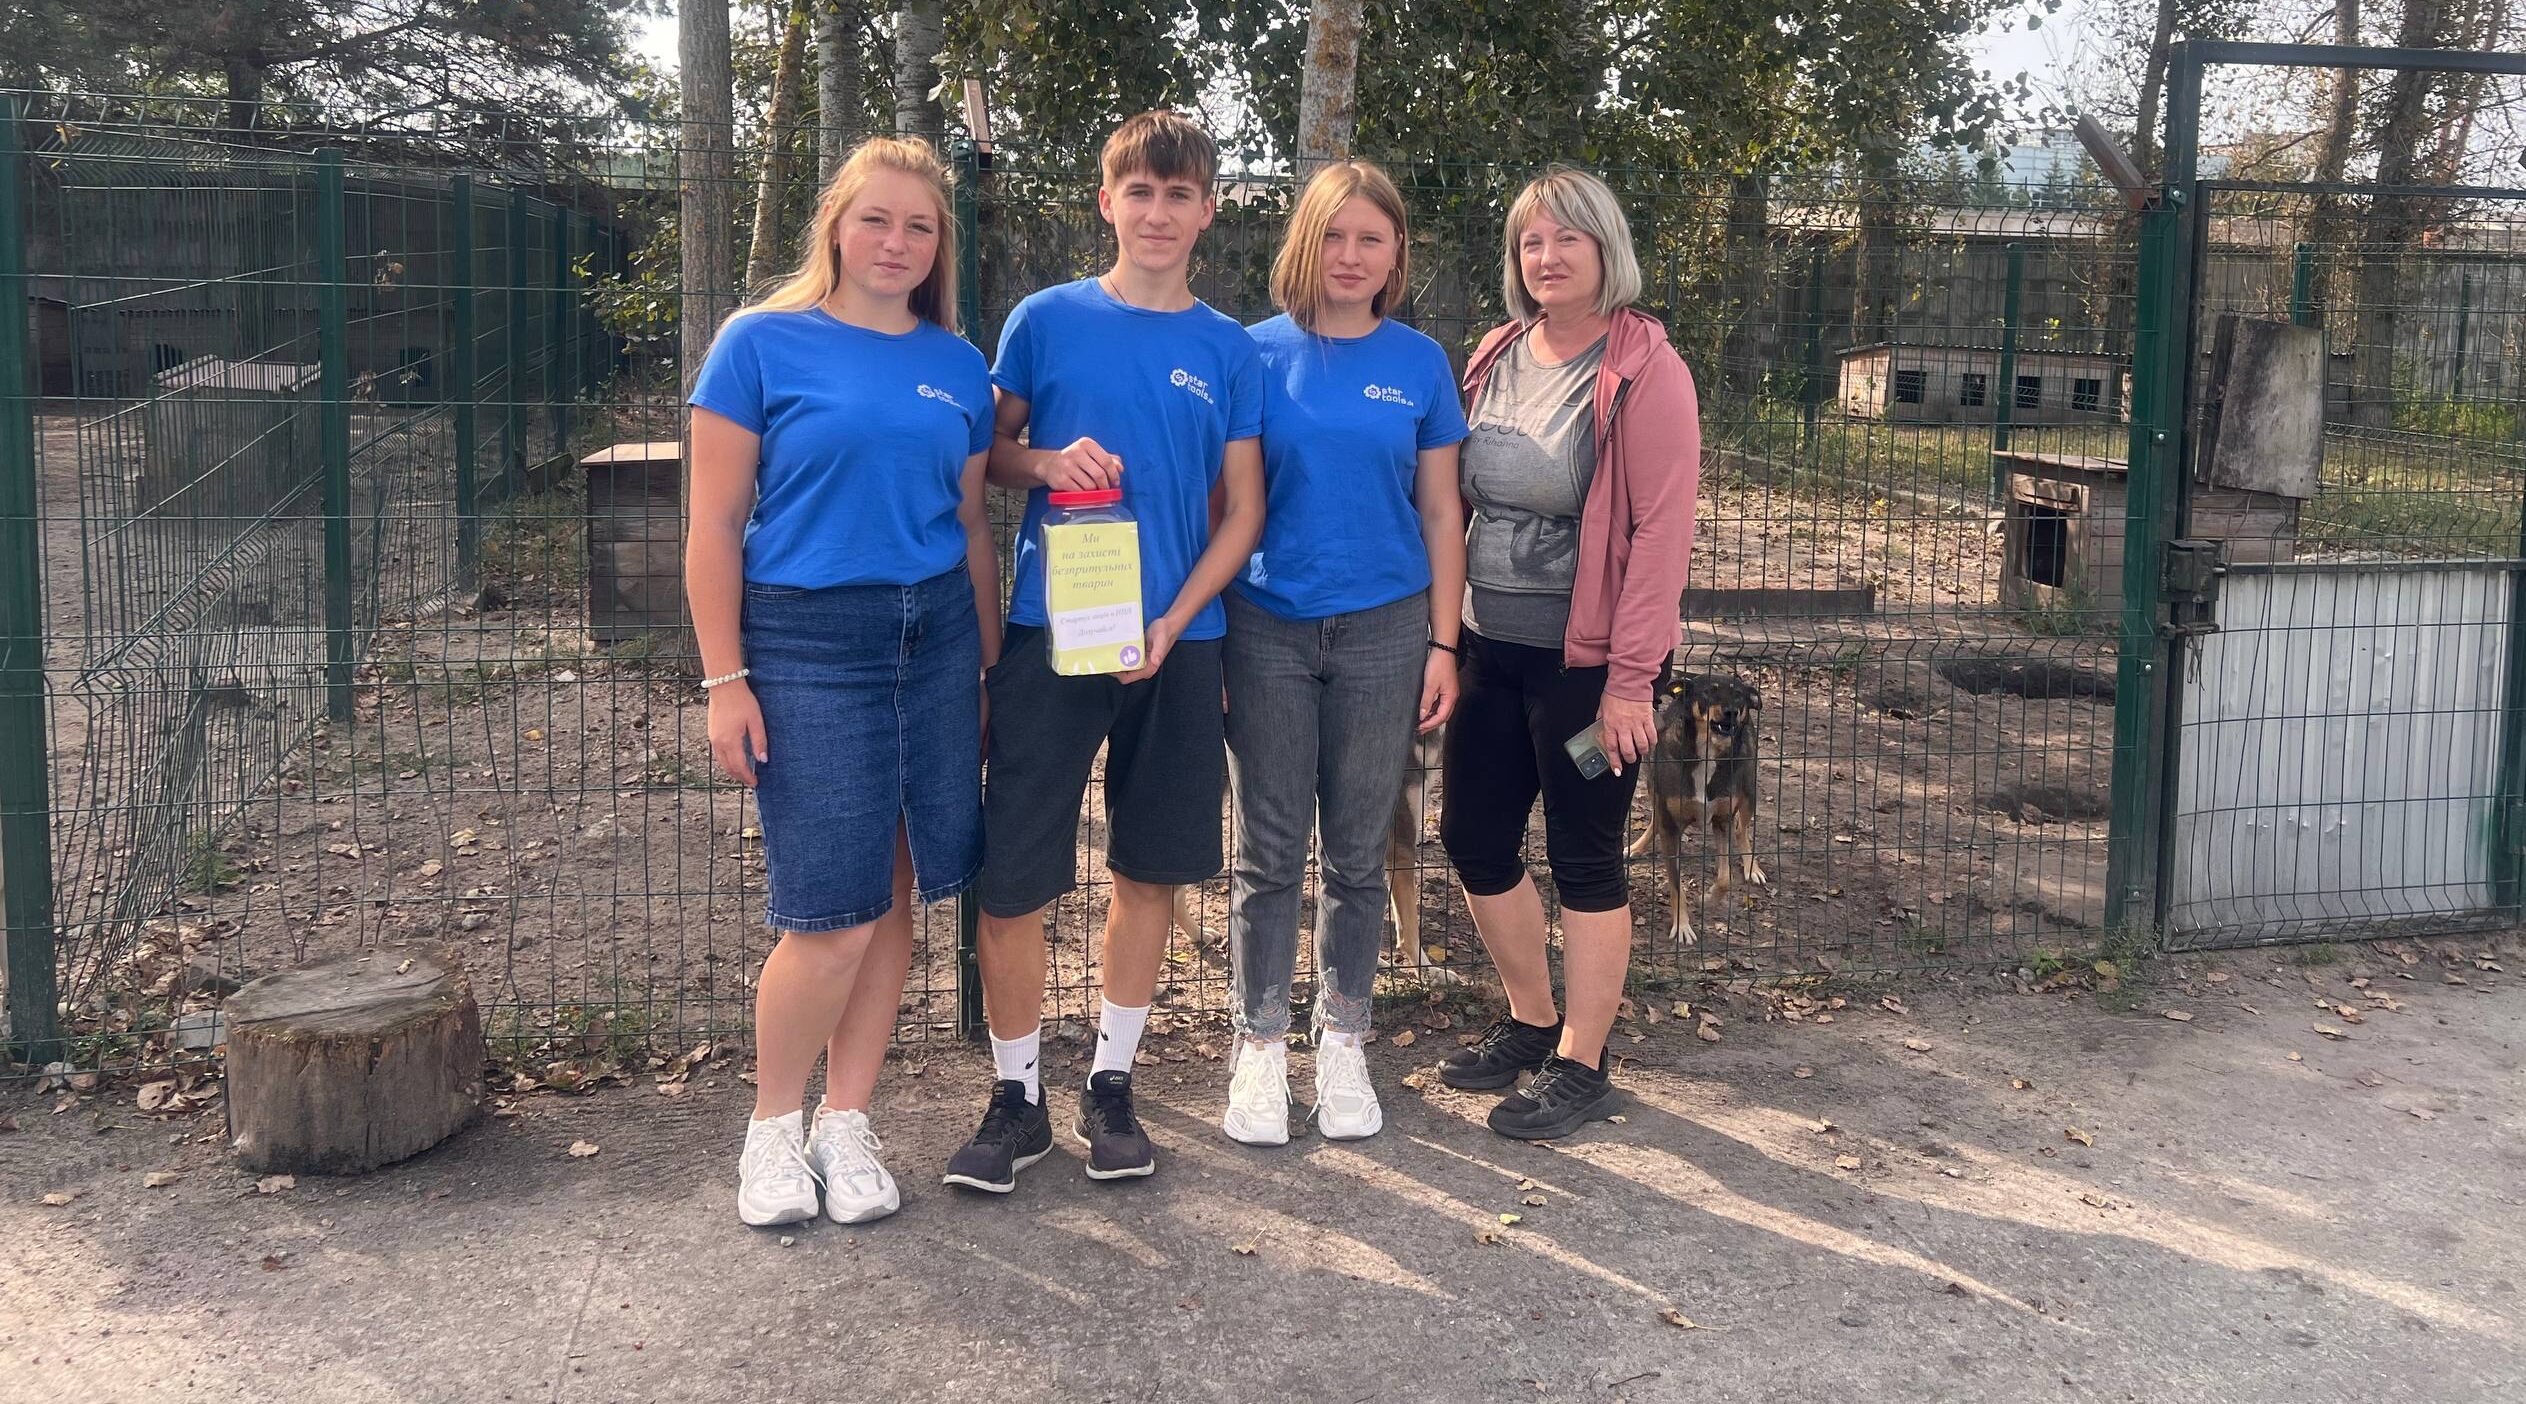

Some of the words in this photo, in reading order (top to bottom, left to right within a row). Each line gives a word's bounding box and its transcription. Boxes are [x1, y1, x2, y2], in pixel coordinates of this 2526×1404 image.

[1188, 375, 1209, 389] star
[1381, 386, 1403, 397] star
[1082, 533, 1100, 543] Ми
[1062, 551, 1076, 560] на
[1078, 548, 1121, 560] захисті
[1052, 563, 1132, 576] безпритульних
[1073, 580, 1113, 590] тварин
